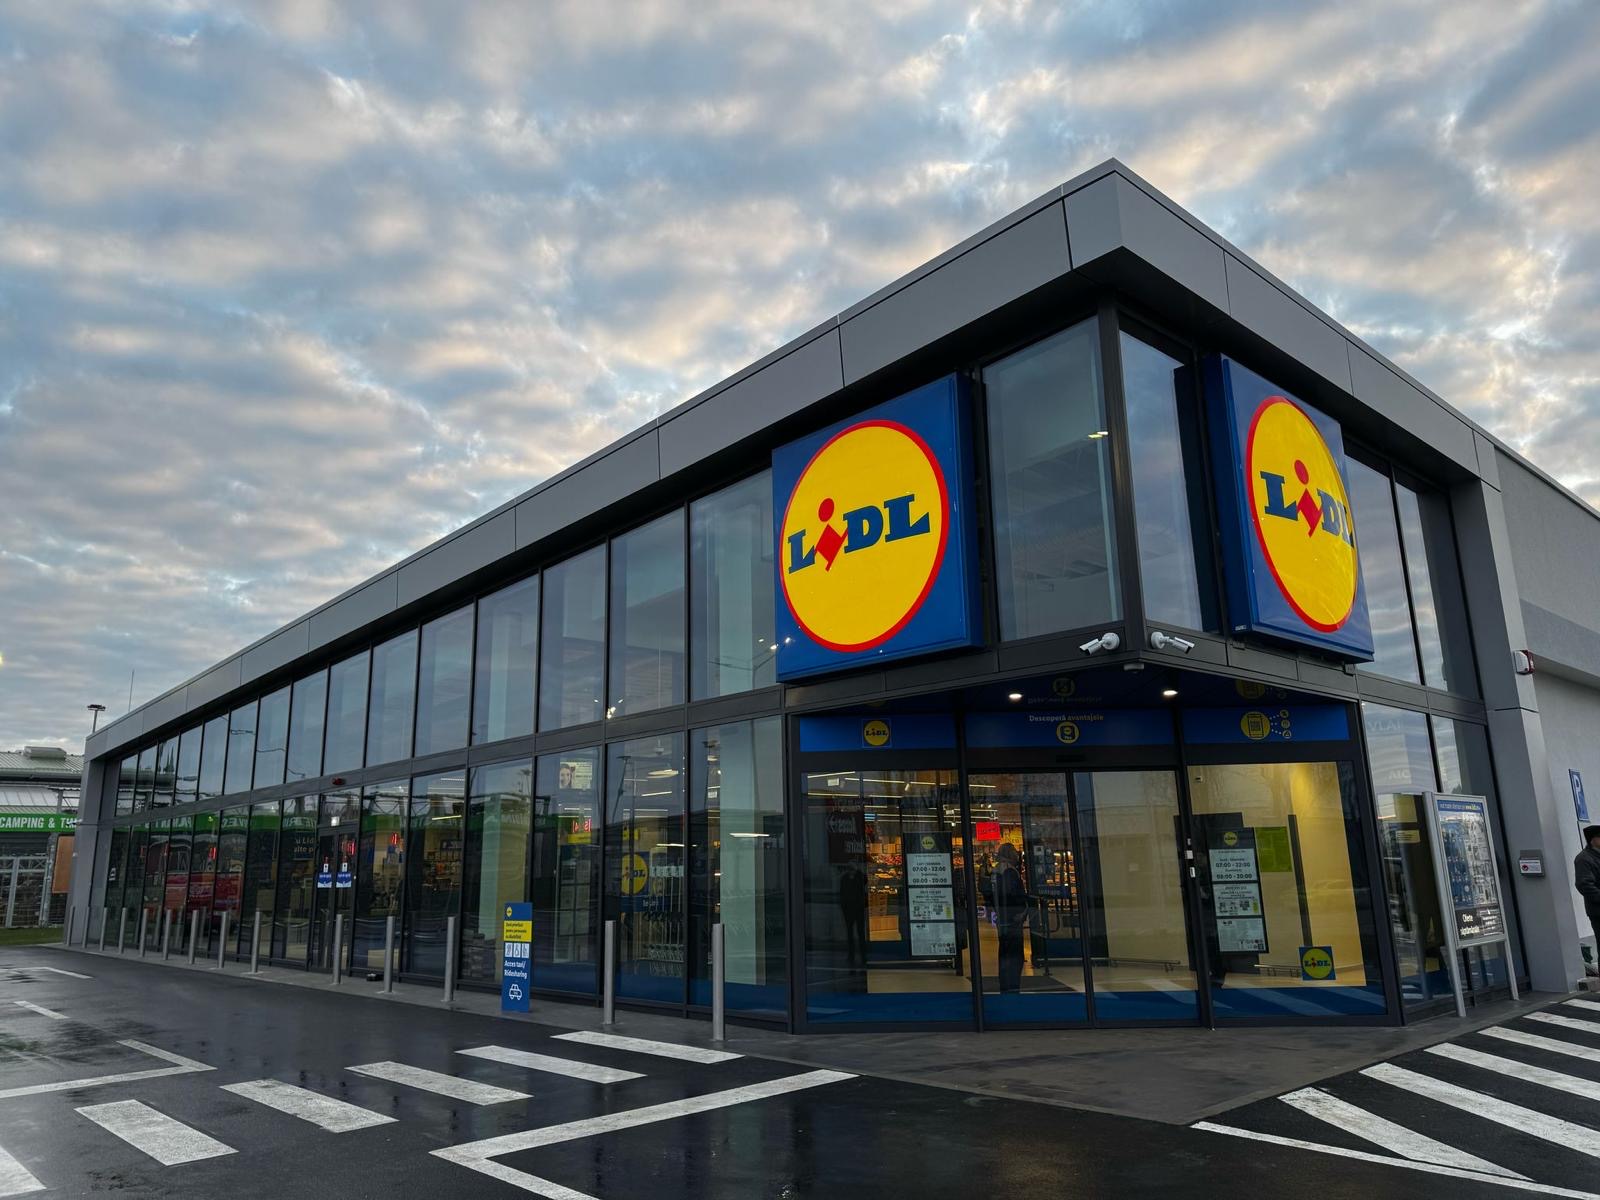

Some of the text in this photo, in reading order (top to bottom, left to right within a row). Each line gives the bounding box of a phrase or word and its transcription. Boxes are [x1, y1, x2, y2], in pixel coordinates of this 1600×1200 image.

[1573, 774, 1581, 804] P
[0, 817, 45, 828] CAMPING
[48, 818, 55, 829] &
[504, 969, 527, 980] Ridesharing
